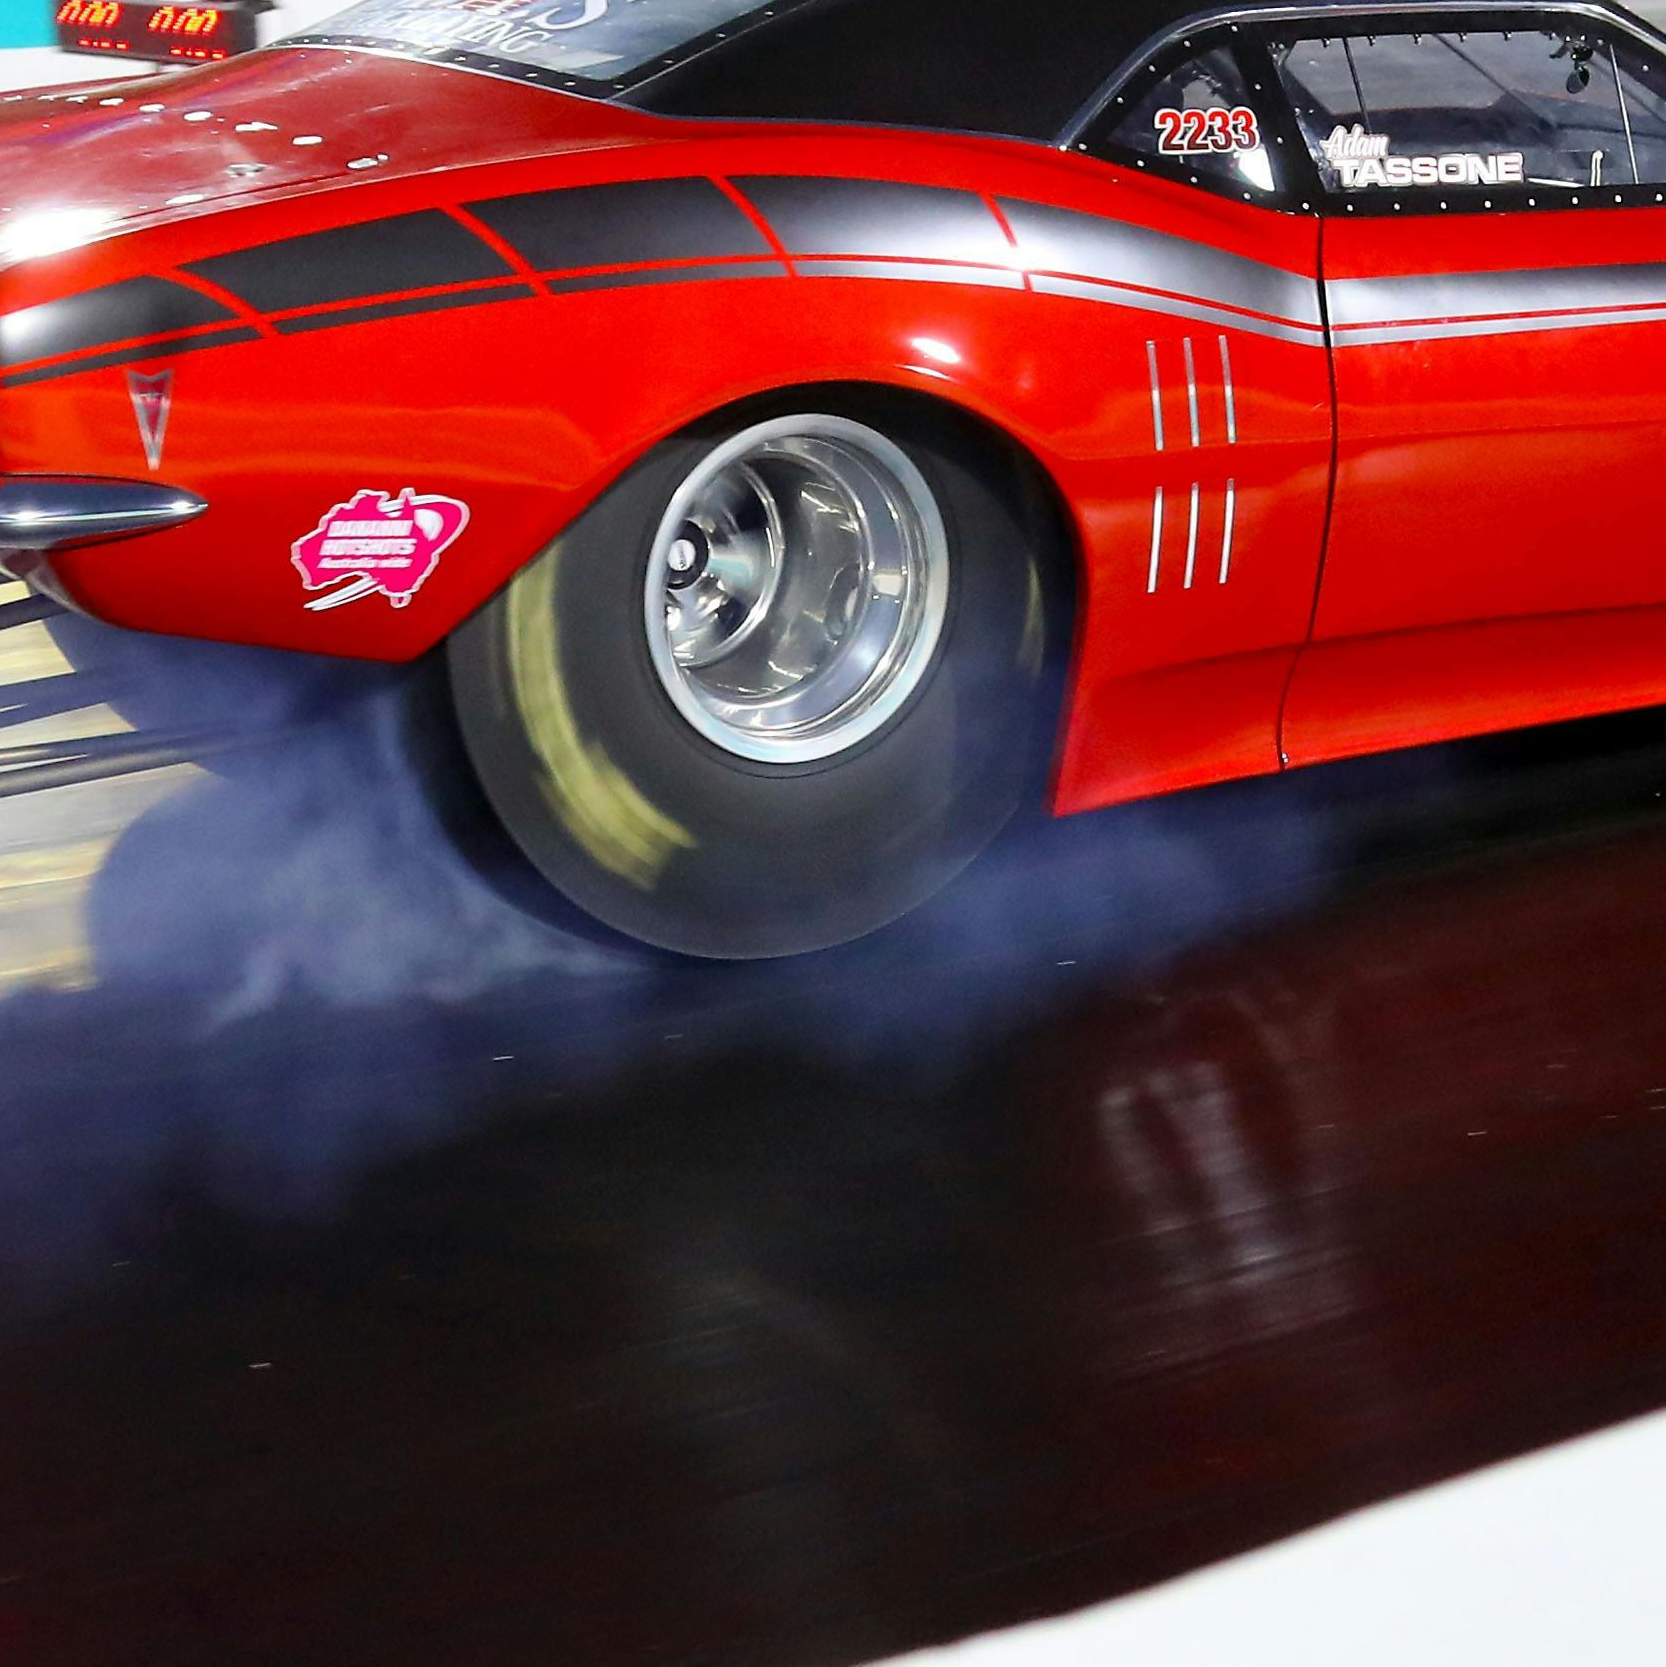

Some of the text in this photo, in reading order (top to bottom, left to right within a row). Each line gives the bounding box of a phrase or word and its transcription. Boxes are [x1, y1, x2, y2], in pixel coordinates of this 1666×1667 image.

[1154, 107, 1260, 154] 2233
[1319, 123, 1390, 157] Adam
[1333, 152, 1523, 187] TASSONE
